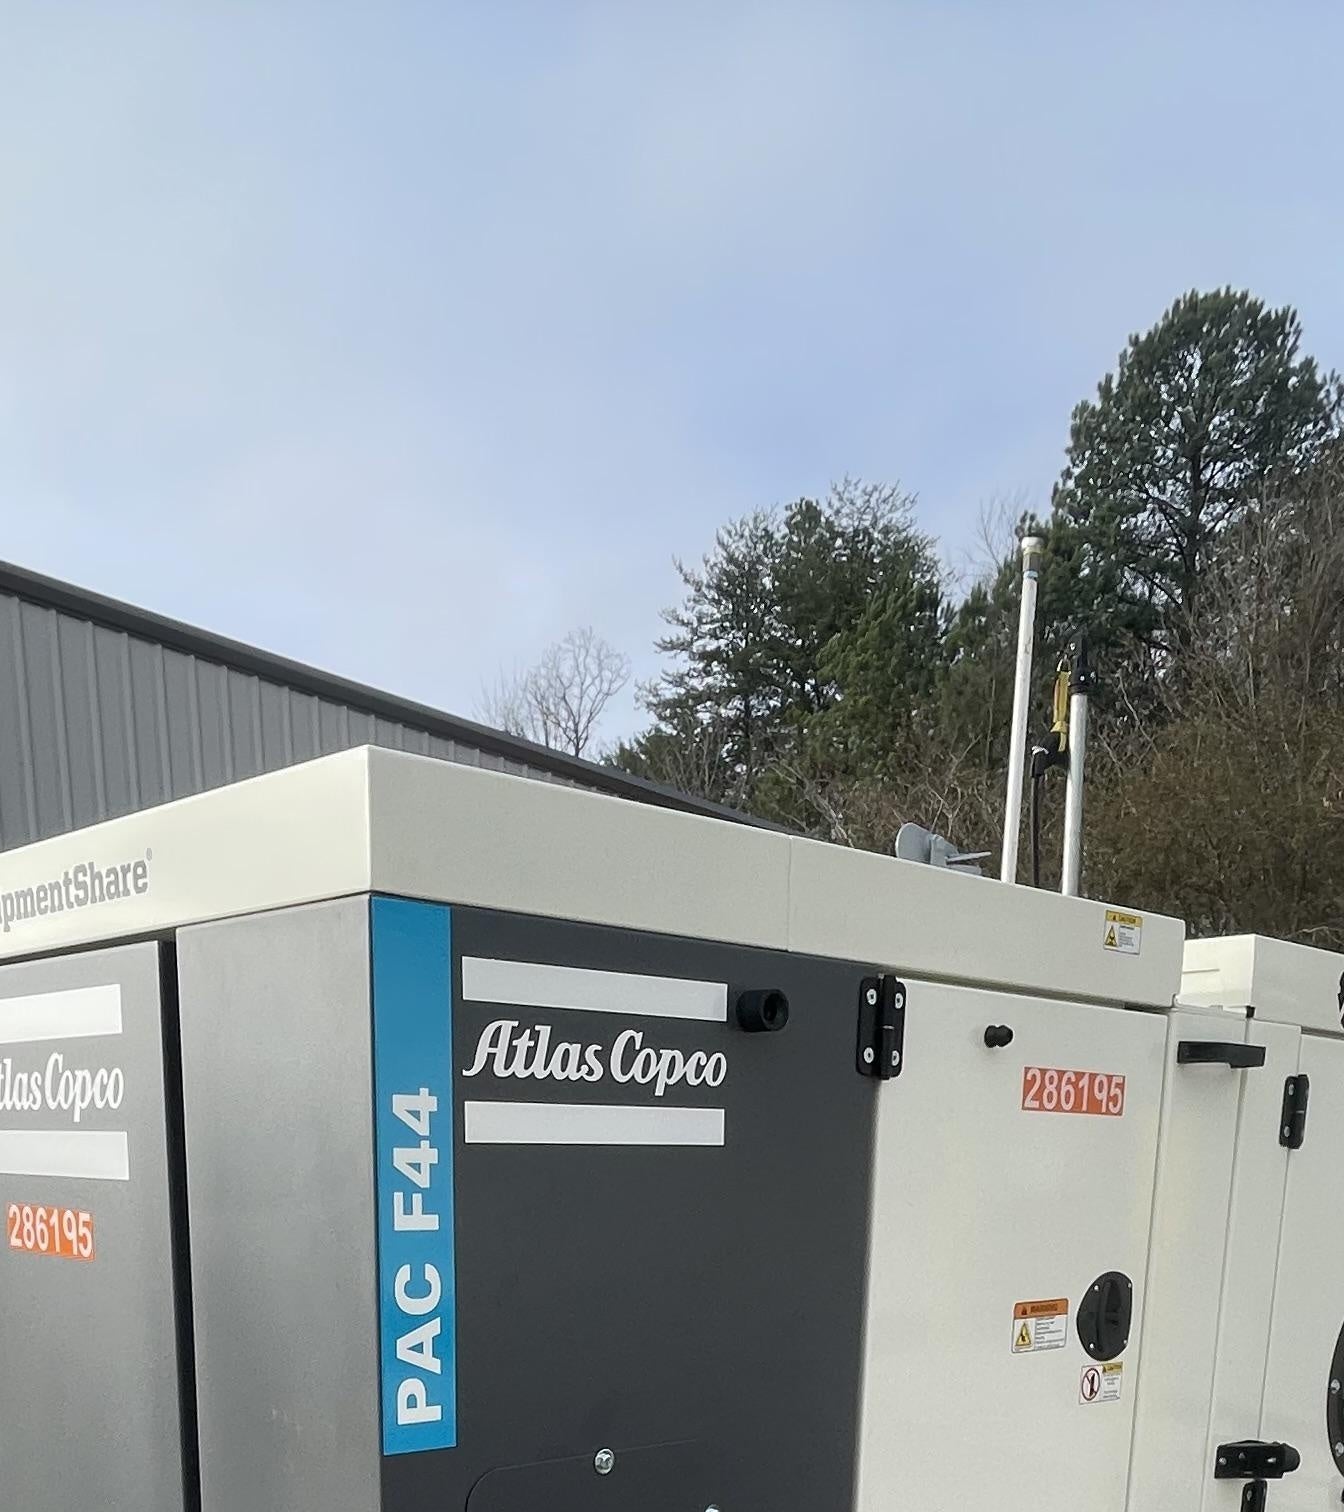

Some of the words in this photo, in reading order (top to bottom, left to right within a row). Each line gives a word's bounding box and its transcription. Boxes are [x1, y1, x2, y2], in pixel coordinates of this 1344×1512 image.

[44, 1052, 125, 1123] Copco
[462, 1019, 604, 1082] Atlas
[610, 1029, 727, 1096] Copco
[1024, 1068, 1124, 1114] 286195
[392, 1087, 440, 1232] F44
[8, 1204, 94, 1259] 286195
[394, 1263, 442, 1426] PAC
